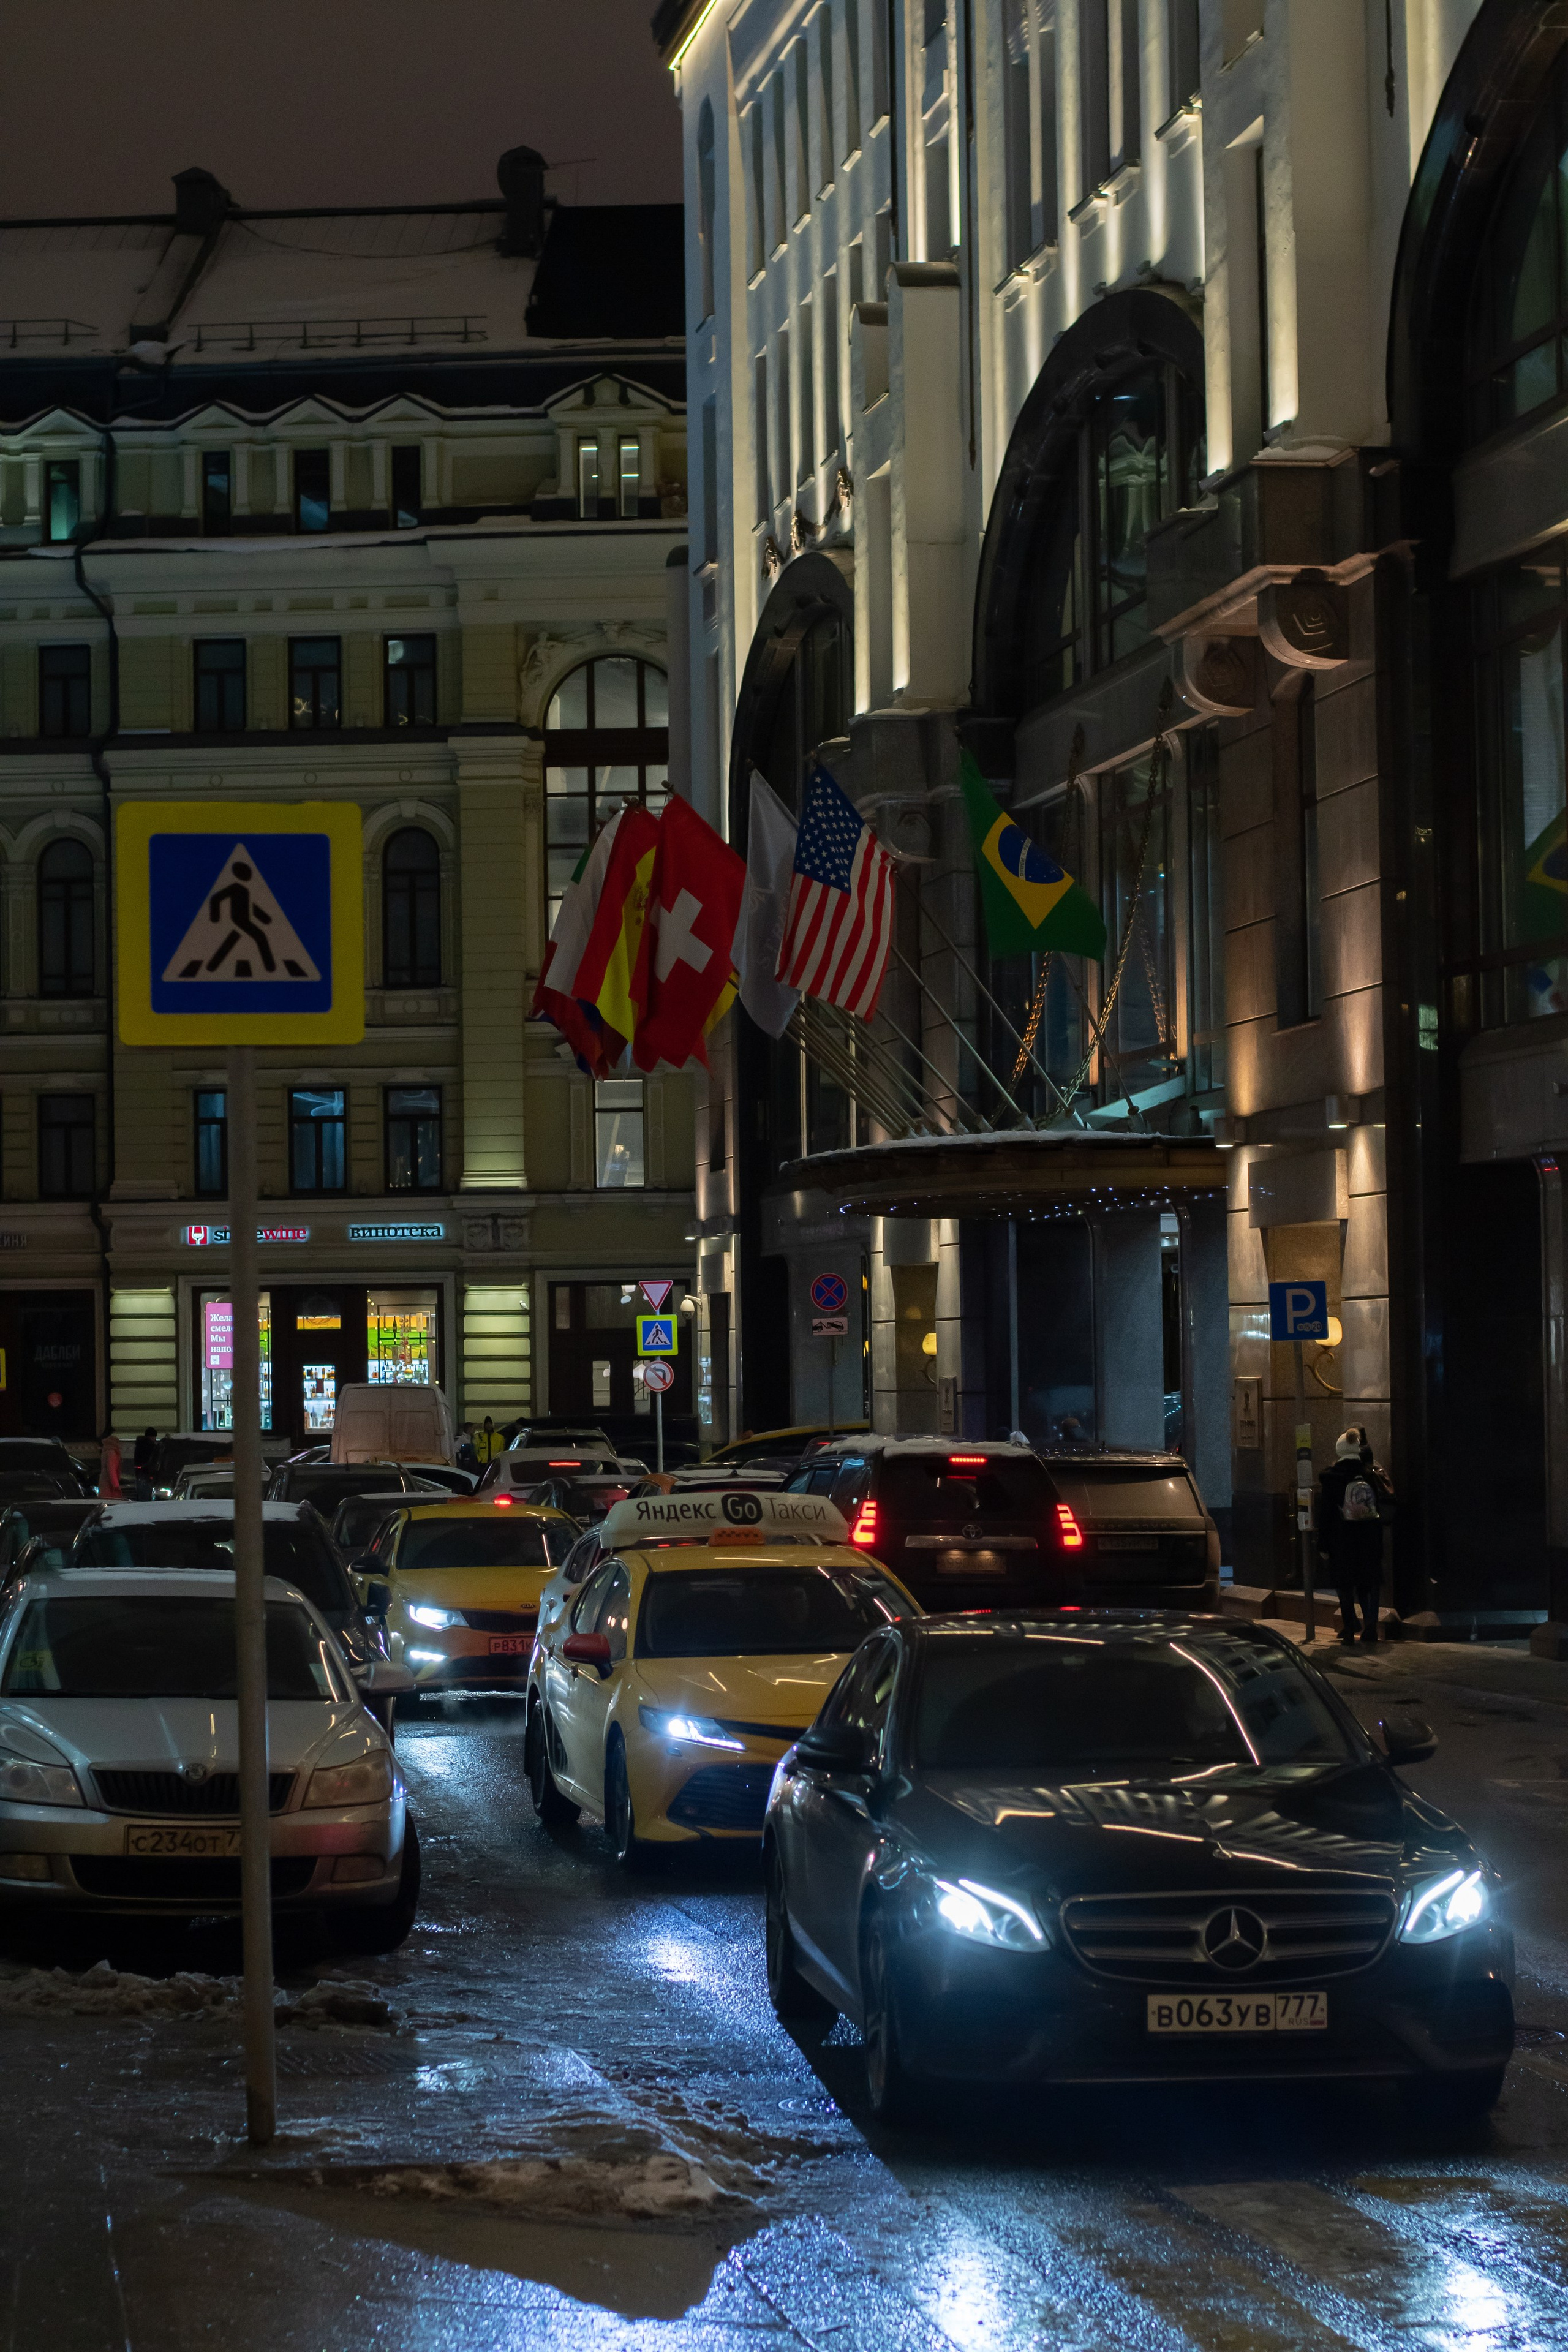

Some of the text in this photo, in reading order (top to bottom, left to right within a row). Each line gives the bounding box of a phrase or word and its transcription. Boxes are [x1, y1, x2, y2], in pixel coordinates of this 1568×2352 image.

[350, 1226, 442, 1238] винотека
[1286, 1288, 1316, 1334] P
[210, 1334, 225, 1343] Мы
[34, 1344, 81, 1362] ДАБЛБИ
[636, 1497, 828, 1523] Яндекс Go Такси
[494, 1640, 532, 1651] Р831К
